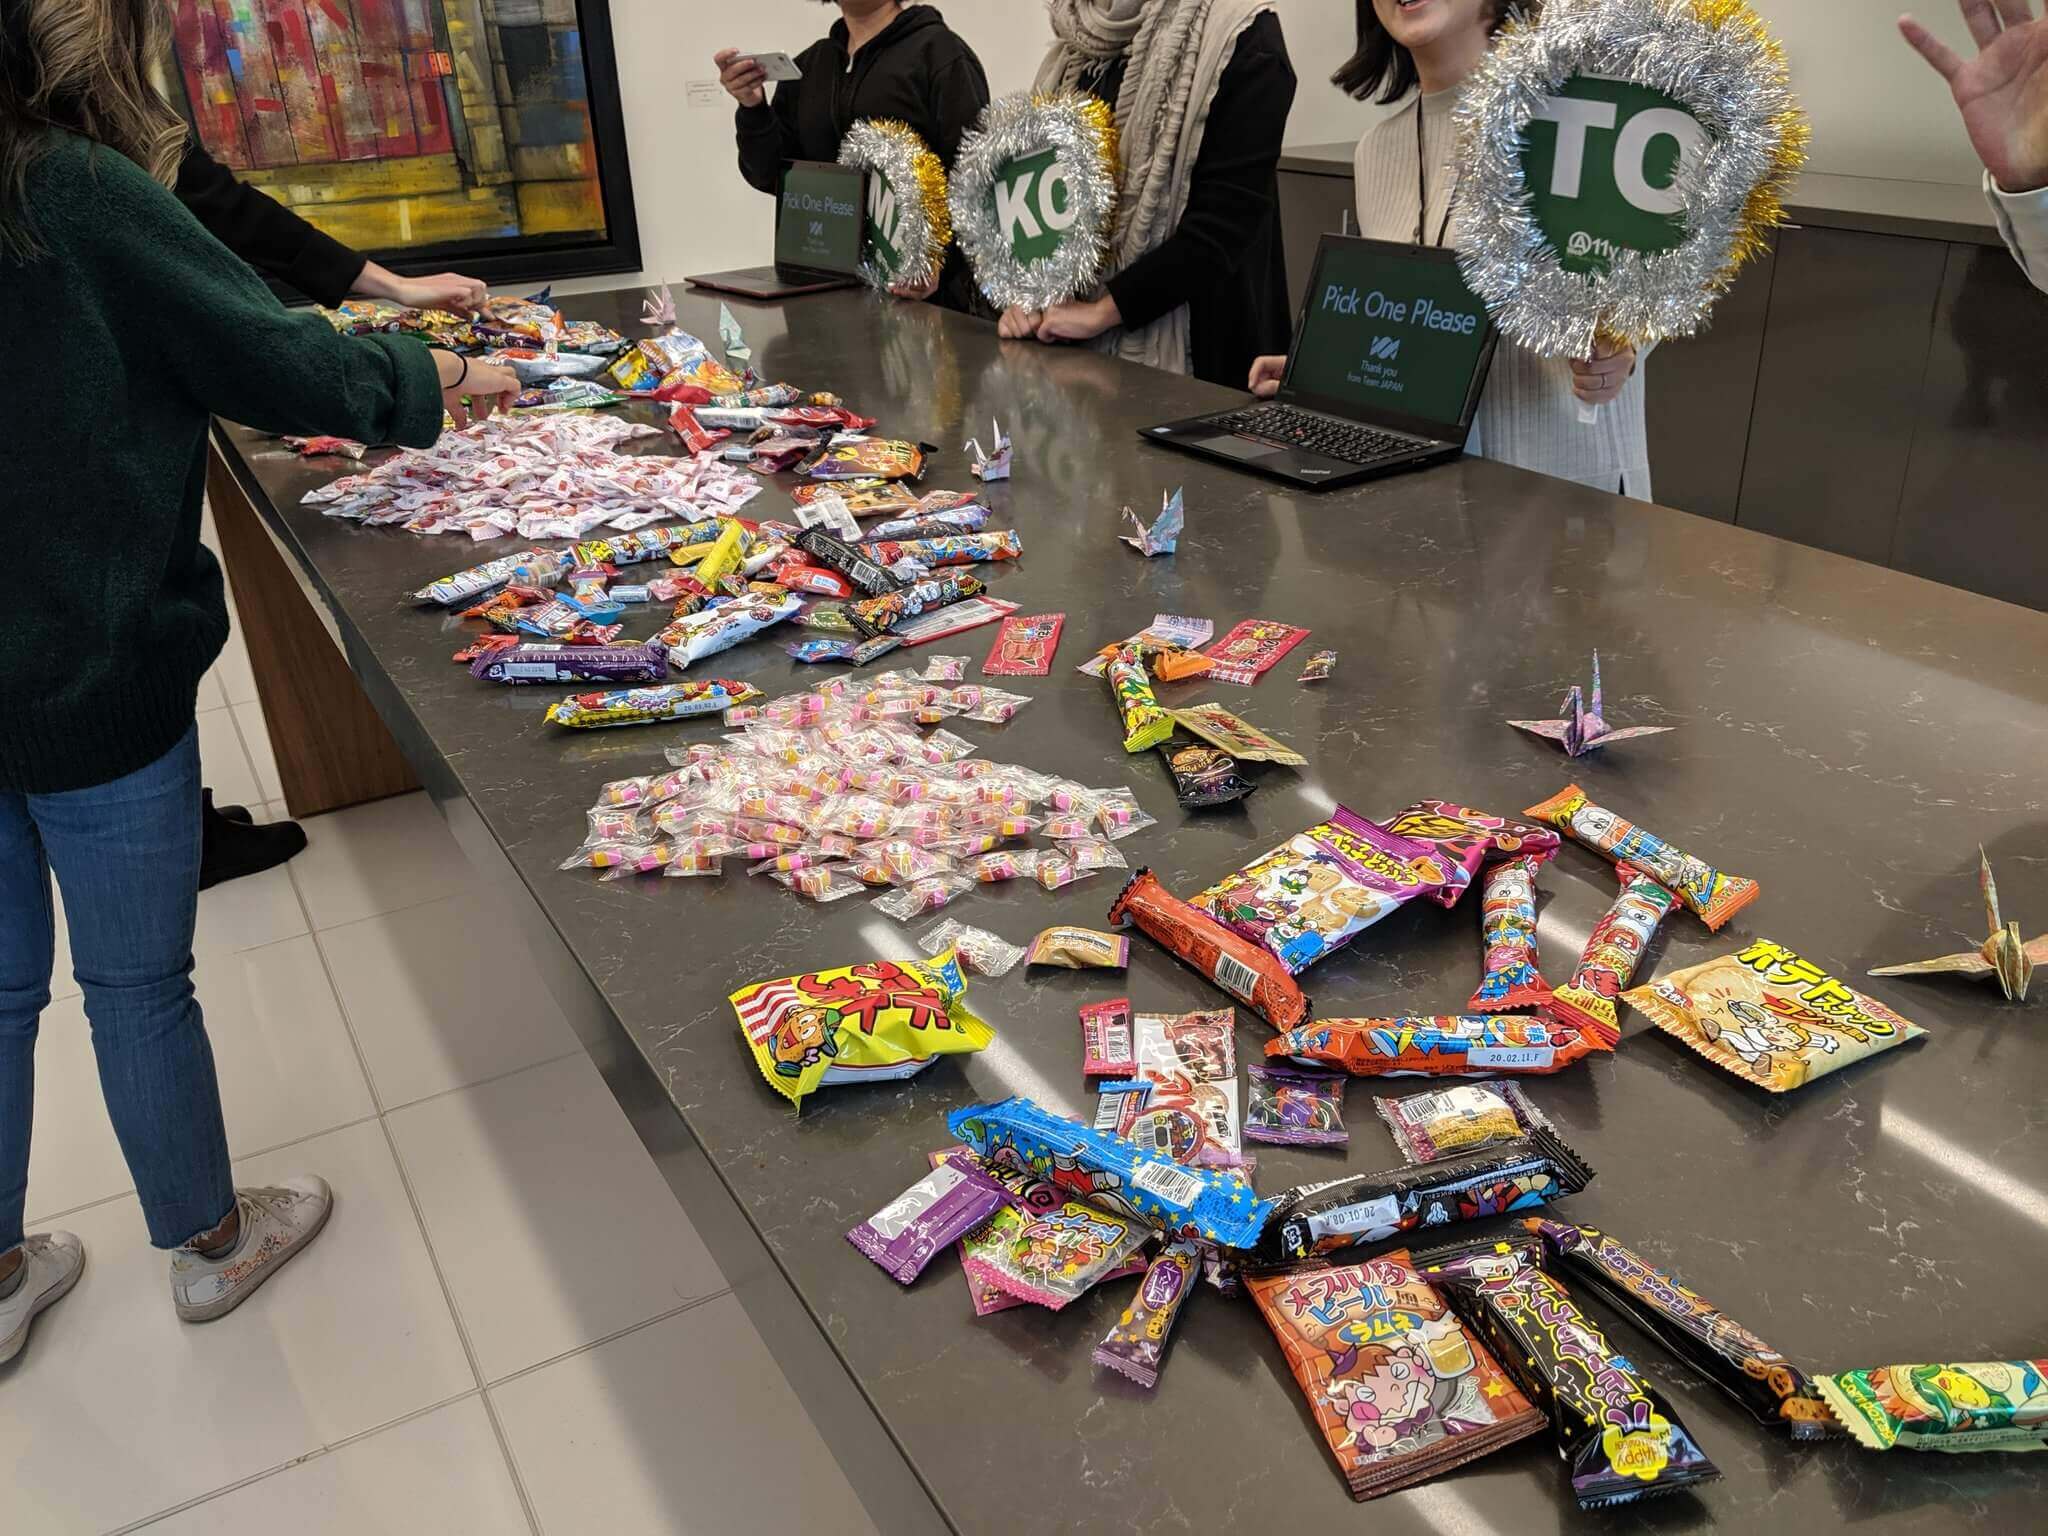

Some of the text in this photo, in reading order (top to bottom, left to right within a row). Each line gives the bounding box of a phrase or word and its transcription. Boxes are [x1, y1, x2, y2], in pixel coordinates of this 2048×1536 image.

[1532, 95, 1708, 214] TO
[824, 195, 855, 216] Please
[994, 161, 1079, 243] KO
[1322, 285, 1476, 334] Pick One Please
[1360, 360, 1398, 379] Thank you
[1380, 378, 1404, 392] JAPAN
[1490, 1051, 1541, 1064] 20.02.11.F
[1635, 1275, 1693, 1317] you
[1350, 1312, 1413, 1341] ラムネ
